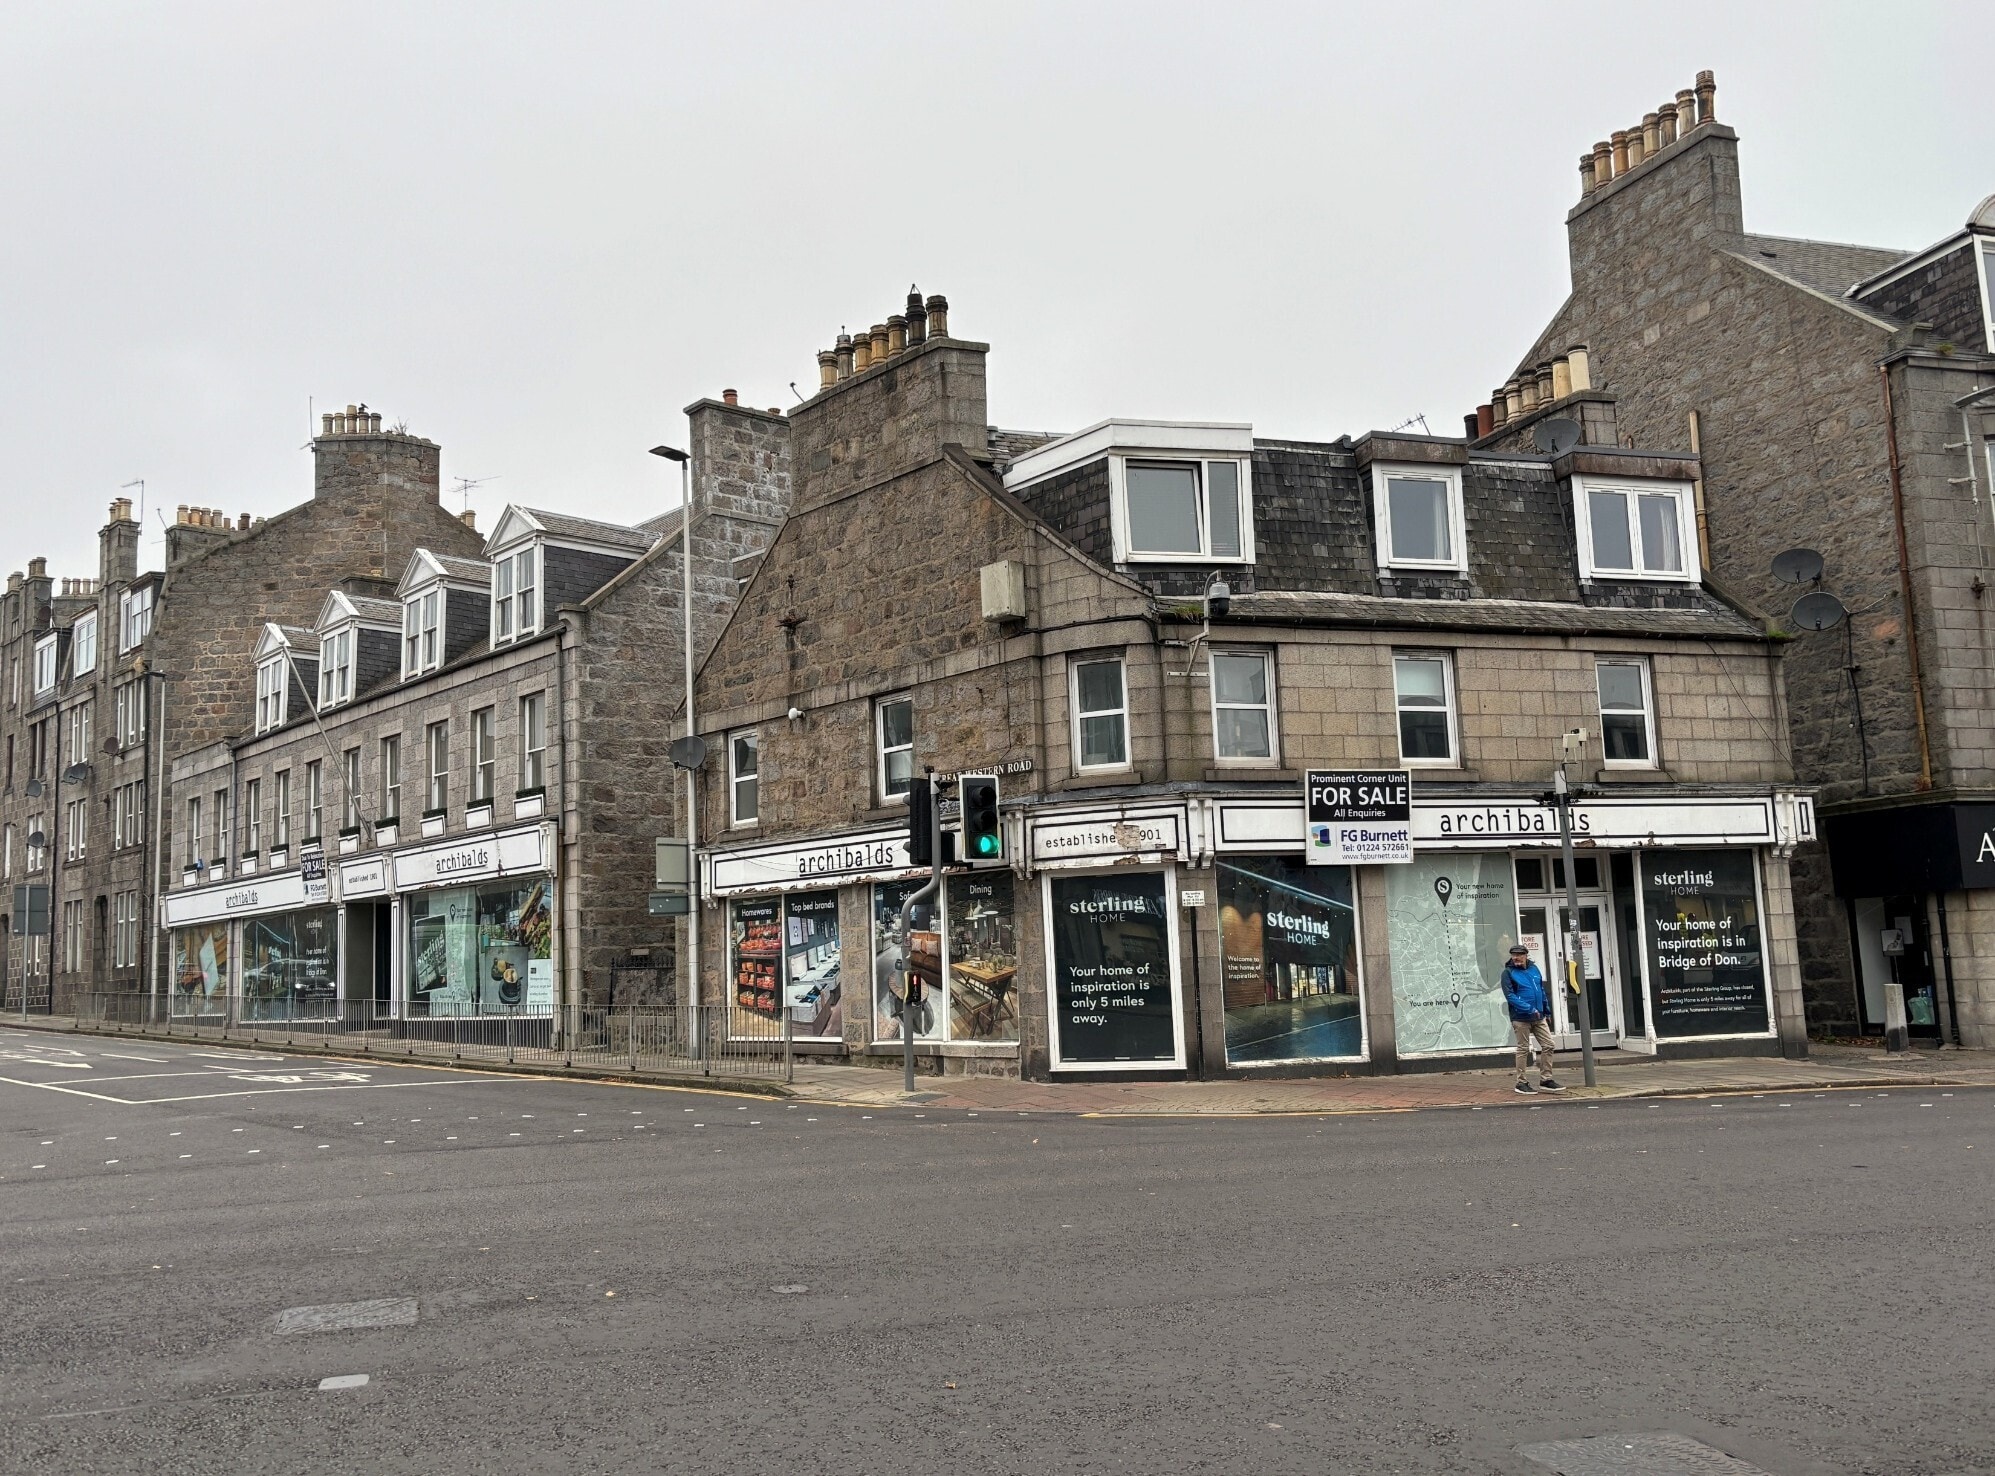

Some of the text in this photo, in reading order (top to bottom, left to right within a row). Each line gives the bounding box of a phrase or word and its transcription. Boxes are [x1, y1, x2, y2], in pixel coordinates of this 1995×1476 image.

[940, 772, 963, 782] REAT
[1007, 760, 1032, 773] ROAD
[1311, 774, 1406, 783] Prominent Corner Unit
[1312, 786, 1407, 806] FOR SALE
[1334, 808, 1386, 819] All Enquiries
[1045, 829, 1162, 848] establishe 901
[1340, 829, 1408, 842] FG Burnett
[1342, 843, 1409, 852] Tel: 01224 572661
[435, 848, 488, 871] archibalds
[799, 843, 893, 873] archibalds
[1342, 852, 1409, 860] www.fgburnett.co.uk
[302, 859, 325, 873] FOR SALE
[1654, 870, 1714, 887] sterling
[969, 884, 992, 896] Dining
[1439, 881, 1447, 891] S
[1670, 886, 1700, 896] HOME
[225, 890, 258, 907] archibalds
[1465, 892, 1500, 901] inspiration
[791, 899, 835, 913] Top bed brands
[1069, 895, 1146, 914] sterling
[741, 908, 772, 917] Homewares
[1090, 912, 1126, 924] HOME
[1266, 910, 1330, 939] sterling
[1656, 916, 1731, 931] Your home of
[1287, 931, 1317, 945] HOME
[1657, 934, 1746, 952] inspiration is in
[1658, 953, 1741, 970] Bridge of Don.
[1069, 962, 1150, 977] Your home of
[1228, 973, 1260, 981] inspiration.
[1070, 979, 1150, 995] inspiration is
[1071, 995, 1145, 1011] only 5 miles
[1072, 1015, 1108, 1026] away.
